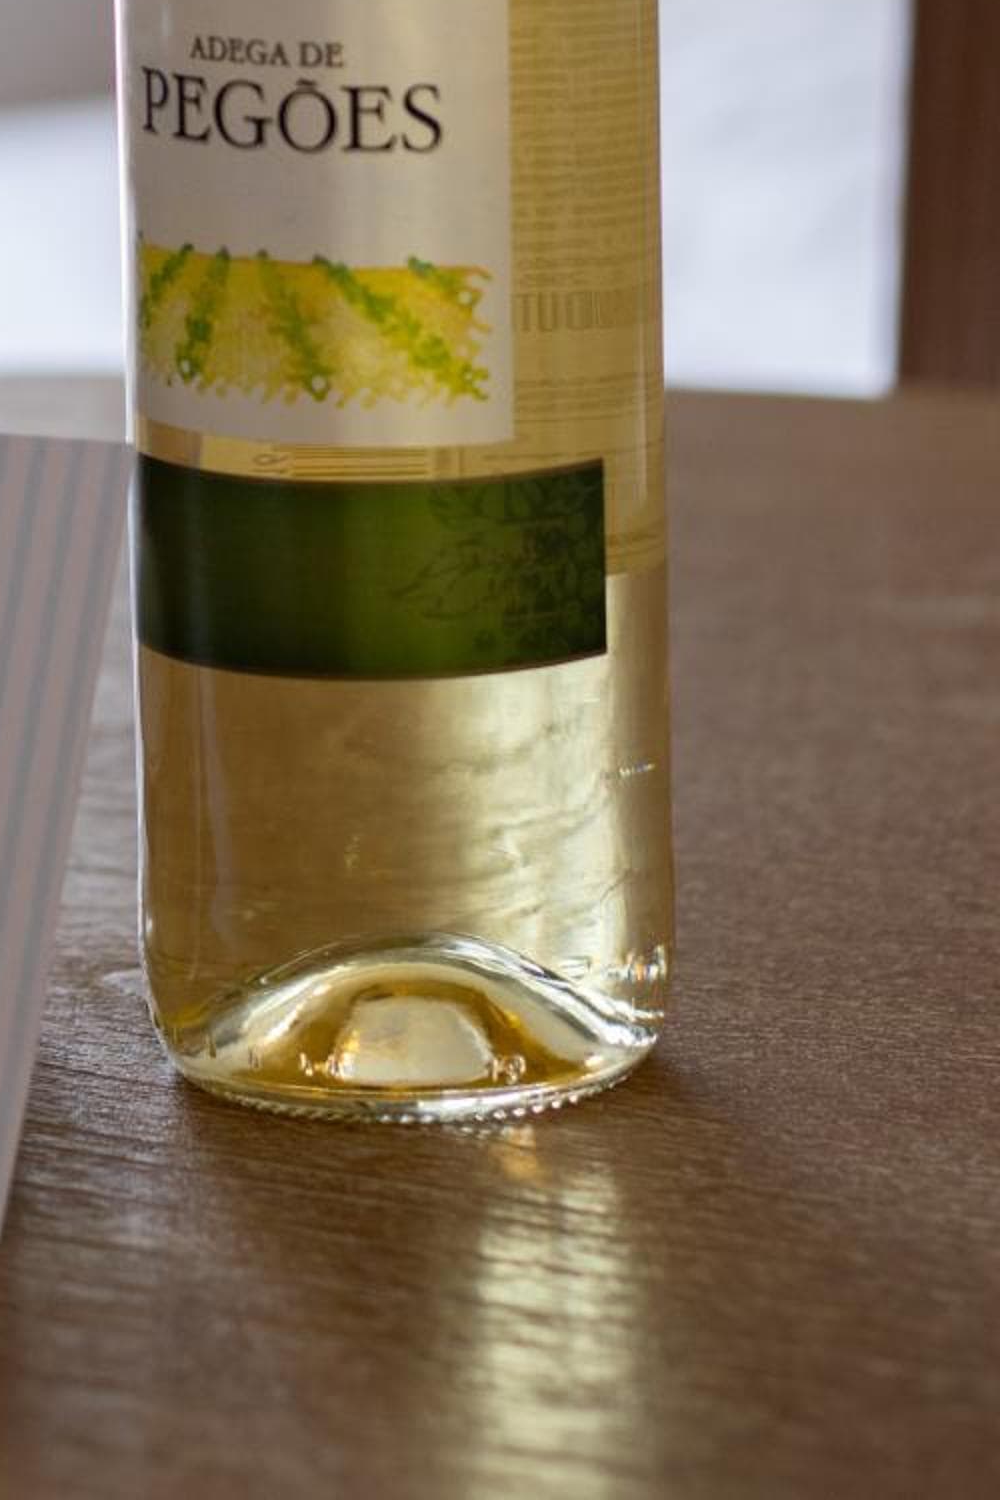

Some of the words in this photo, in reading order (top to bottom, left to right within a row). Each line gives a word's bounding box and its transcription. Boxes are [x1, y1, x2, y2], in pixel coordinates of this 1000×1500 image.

[189, 36, 290, 67] ADEGA
[299, 42, 345, 69] DE
[141, 65, 441, 154] PEGÕES
